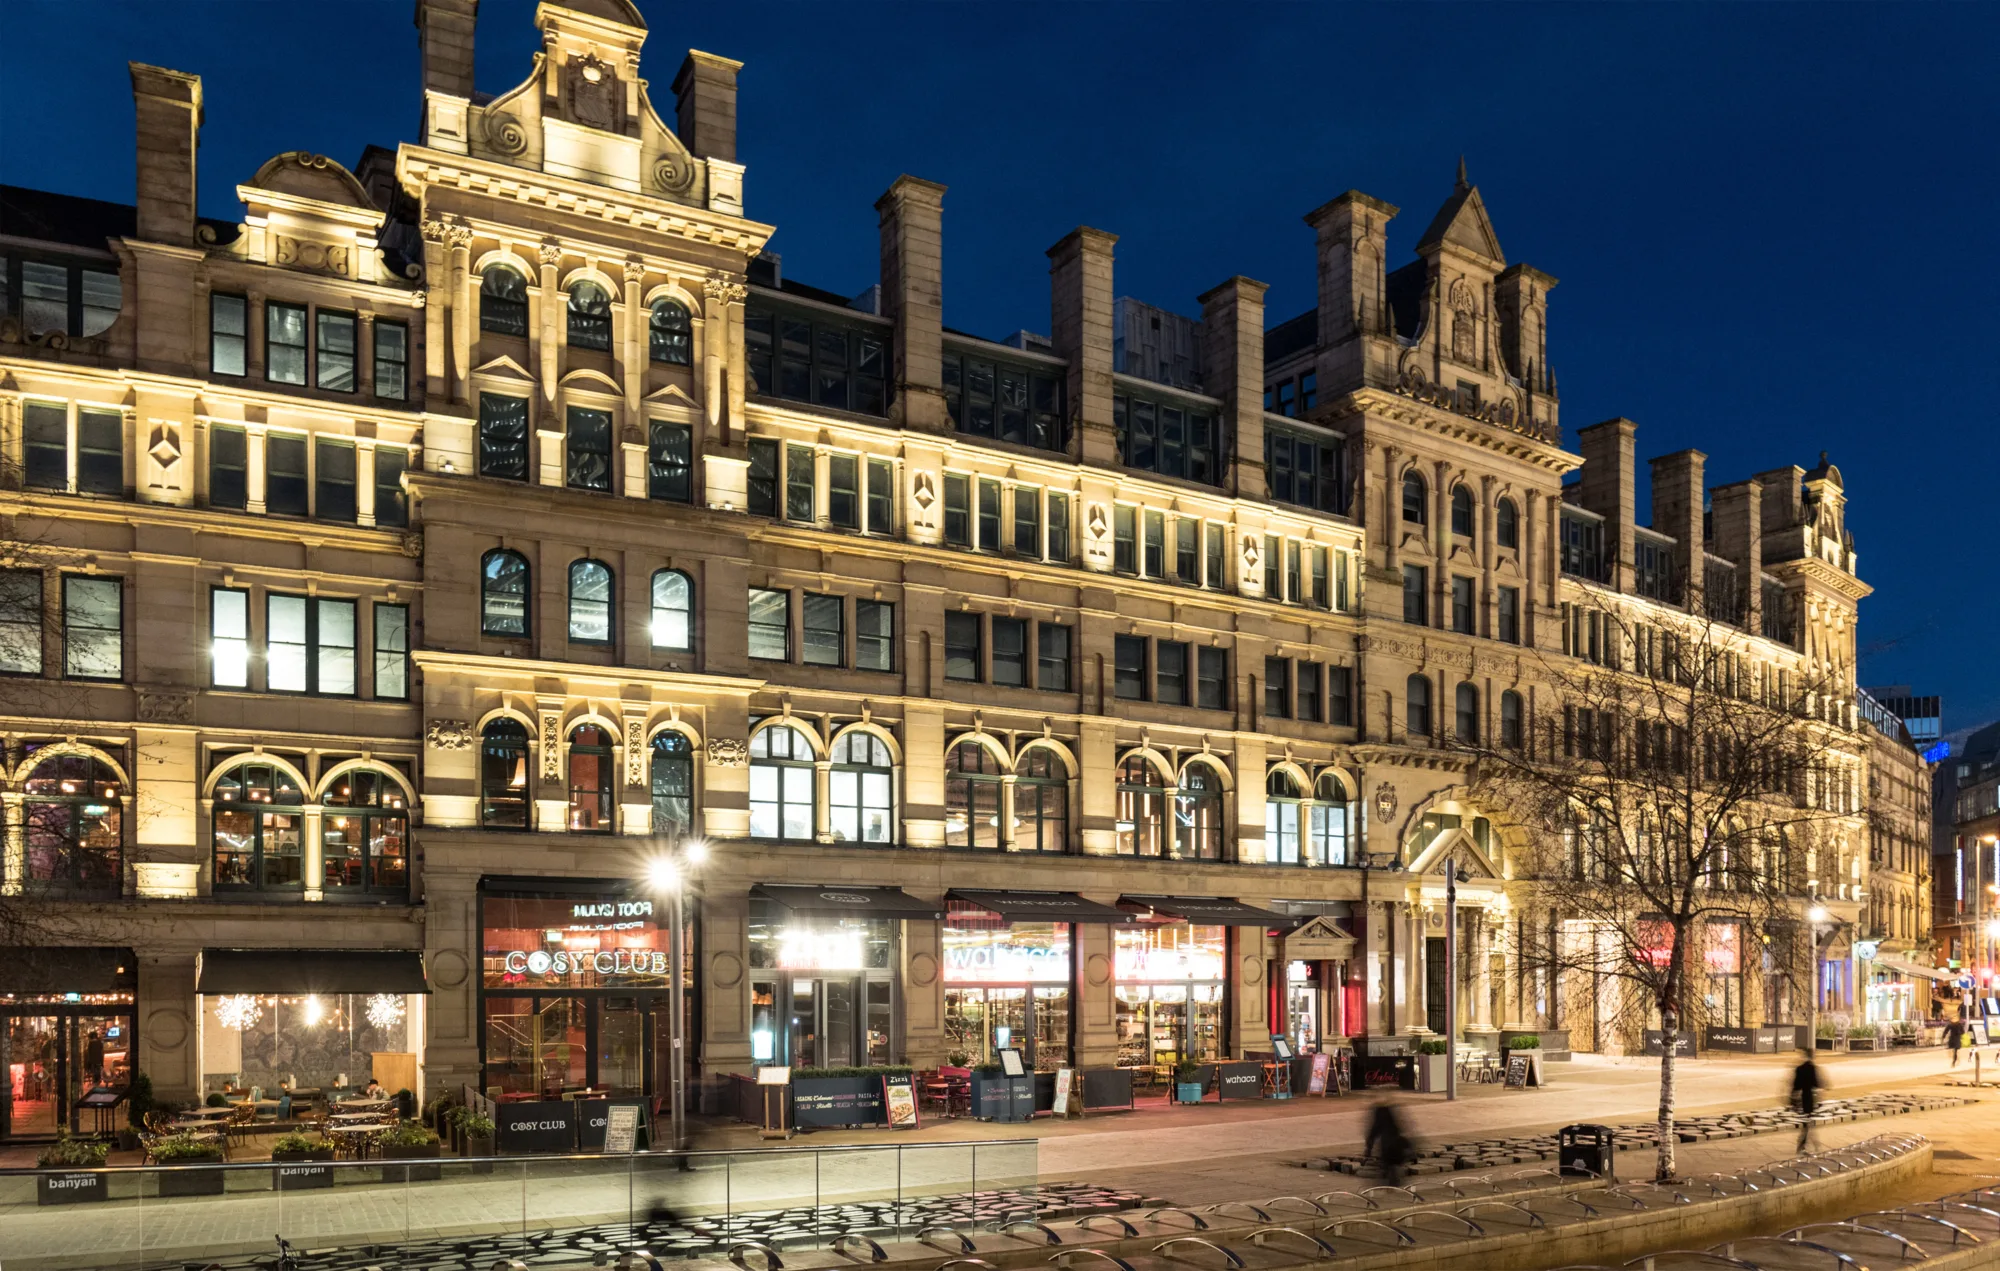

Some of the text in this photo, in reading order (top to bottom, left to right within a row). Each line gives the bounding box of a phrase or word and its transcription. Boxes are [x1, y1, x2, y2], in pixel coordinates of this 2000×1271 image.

[506, 950, 667, 974] COSY CLUB
[1225, 1075, 1256, 1084] wahaca
[510, 1120, 566, 1131] COSY CLUB
[49, 1178, 97, 1189] banyan
